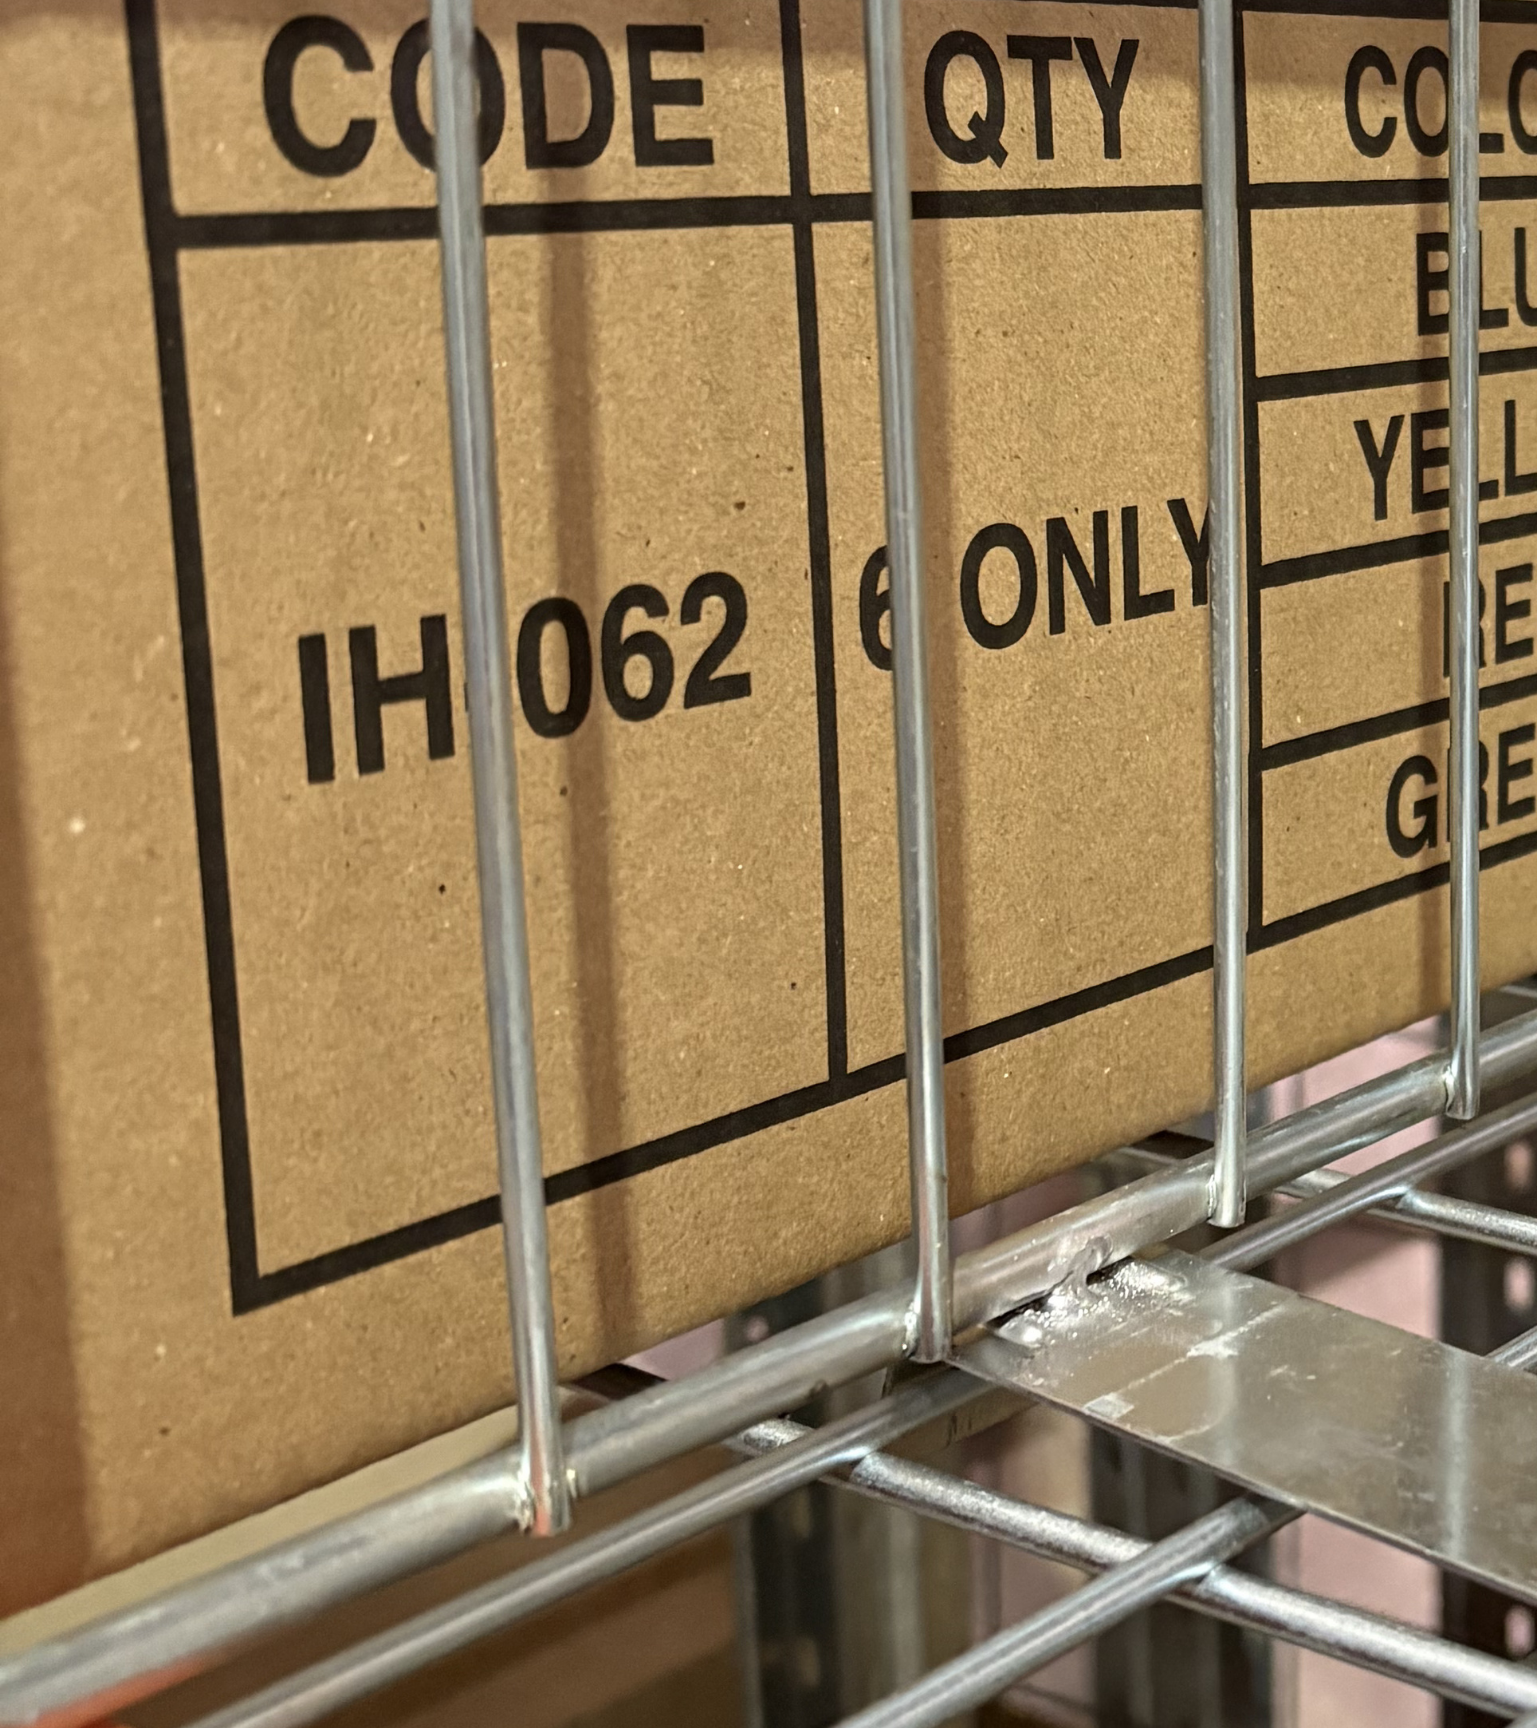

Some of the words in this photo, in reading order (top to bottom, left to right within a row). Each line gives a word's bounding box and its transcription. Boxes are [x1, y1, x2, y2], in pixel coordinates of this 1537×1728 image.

[263, 15, 714, 178] CODE
[924, 30, 1140, 169] QTY
[960, 498, 1209, 649] ONLY
